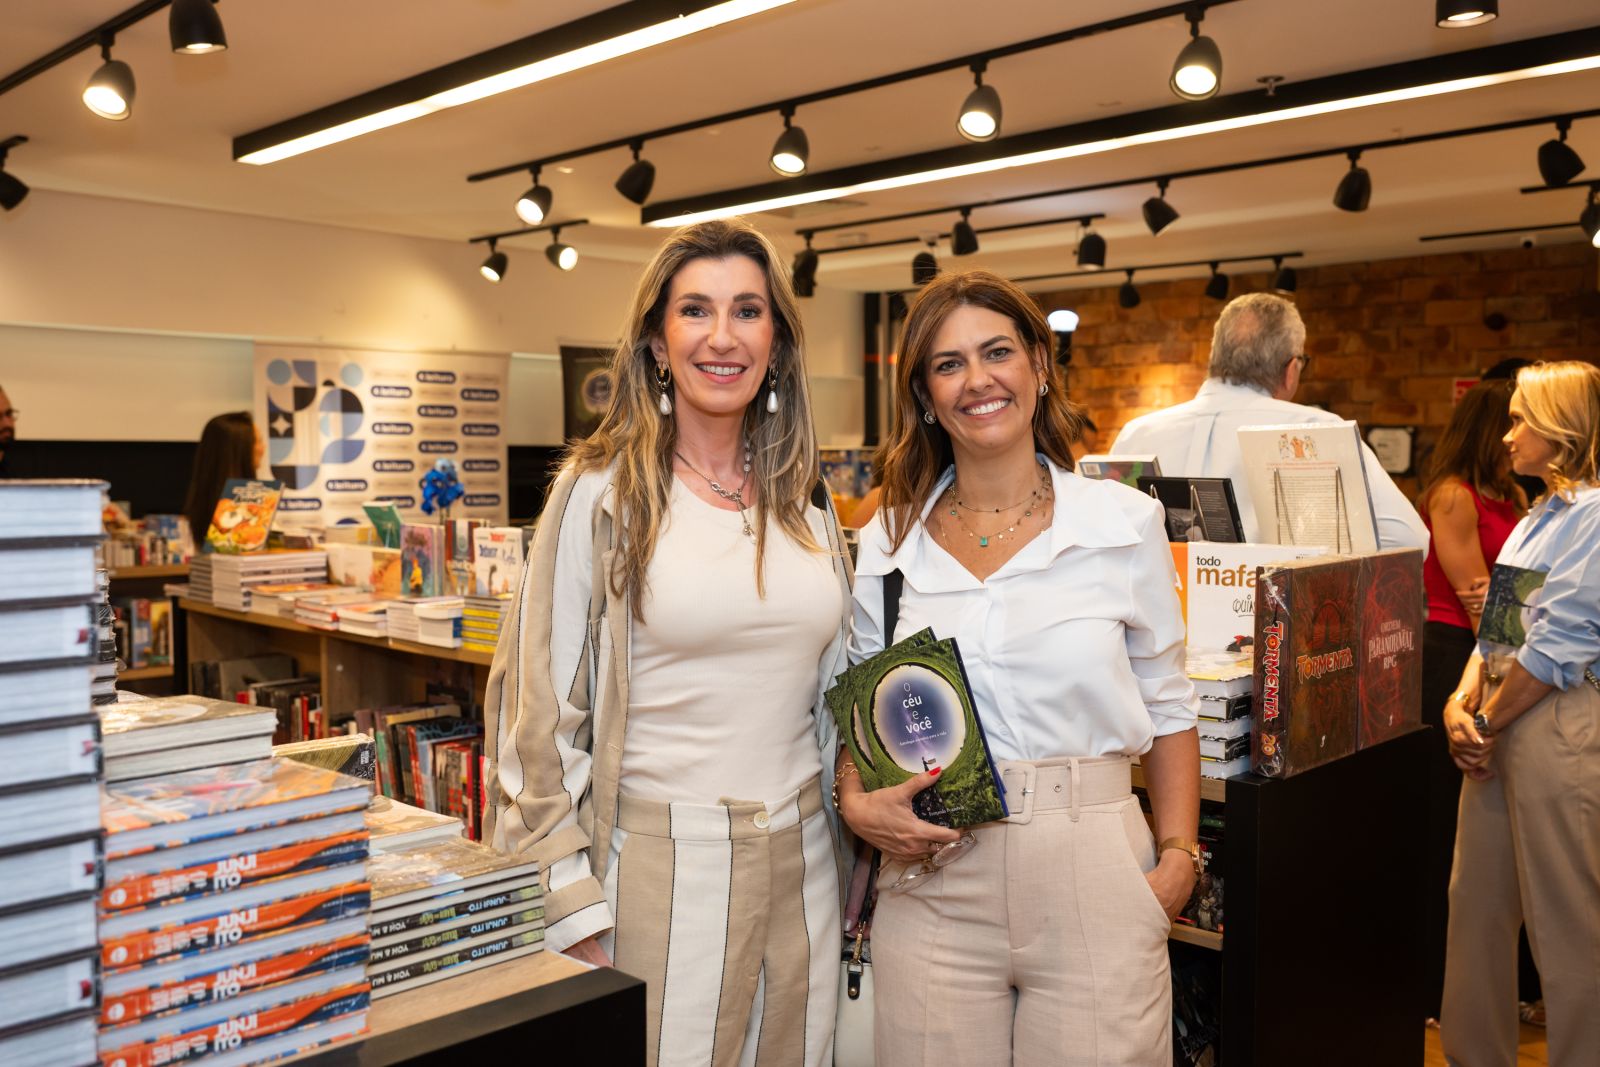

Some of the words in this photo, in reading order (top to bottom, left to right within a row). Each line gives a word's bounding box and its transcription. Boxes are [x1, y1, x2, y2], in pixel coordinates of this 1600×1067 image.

[1196, 555, 1221, 567] todo
[1263, 620, 1284, 722] TORMENTA
[1296, 646, 1354, 684] TORMENTA
[903, 682, 911, 692] O
[902, 693, 922, 709] céu
[912, 710, 920, 720] e
[905, 716, 932, 734] você
[215, 854, 257, 875] JUNJI
[213, 873, 242, 890] ITO
[216, 908, 258, 929] JUNJI
[214, 927, 243, 944] ITO
[215, 963, 257, 984] JUNJI
[213, 982, 241, 1000] ITO
[216, 1013, 258, 1036] JUNJI
[213, 1033, 242, 1052] ITO
